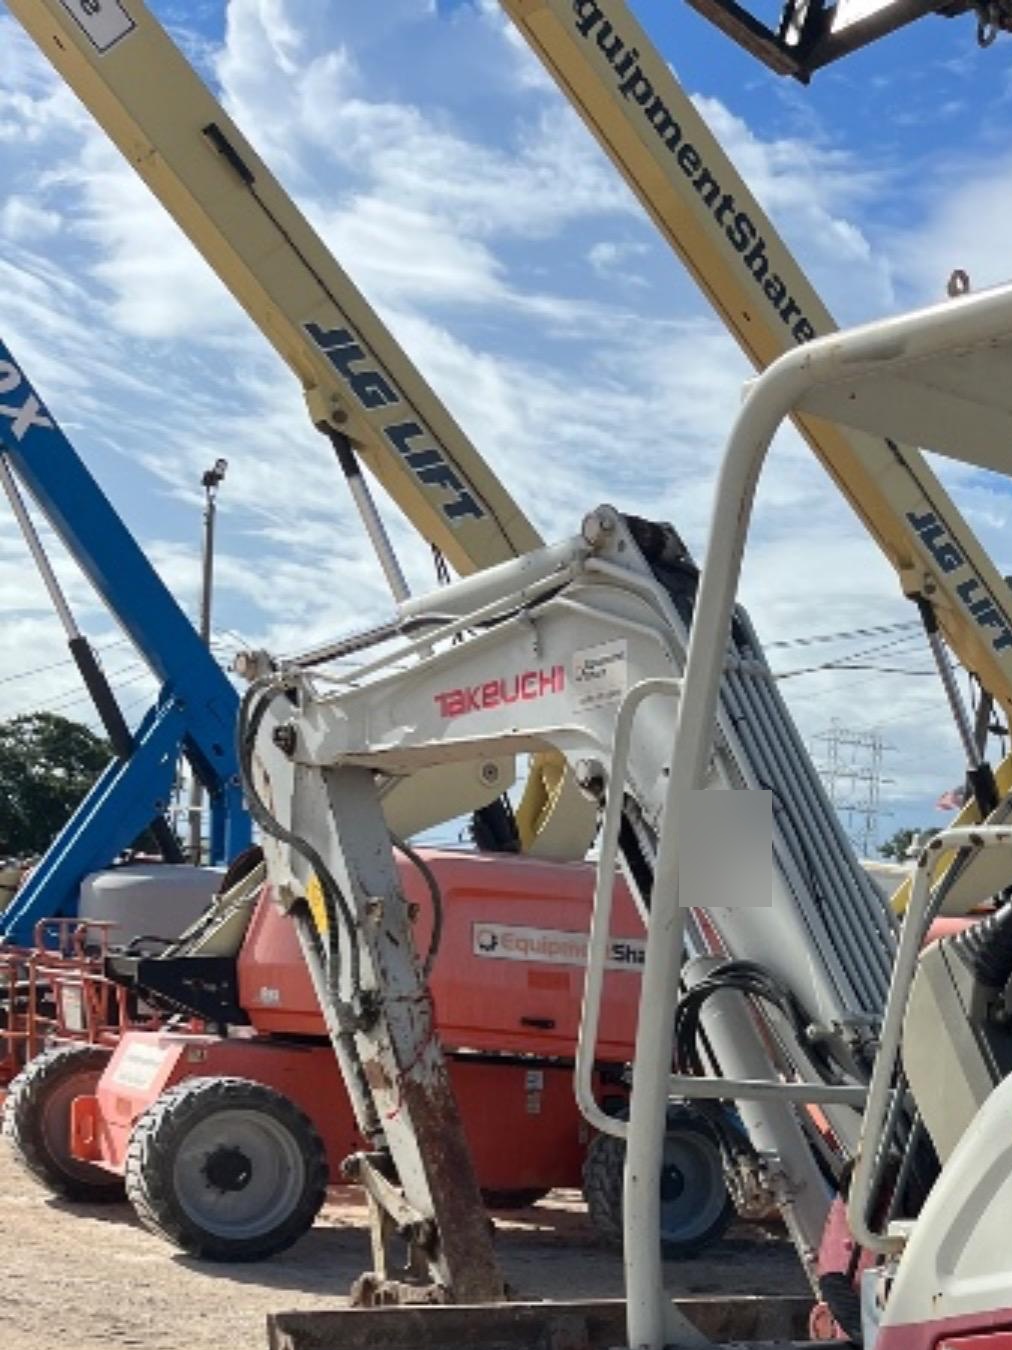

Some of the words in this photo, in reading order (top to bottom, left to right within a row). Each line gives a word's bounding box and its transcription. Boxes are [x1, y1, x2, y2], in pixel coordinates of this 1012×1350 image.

[304, 321, 400, 409] JLG
[383, 421, 485, 520] LIFT
[905, 511, 964, 574] JLG
